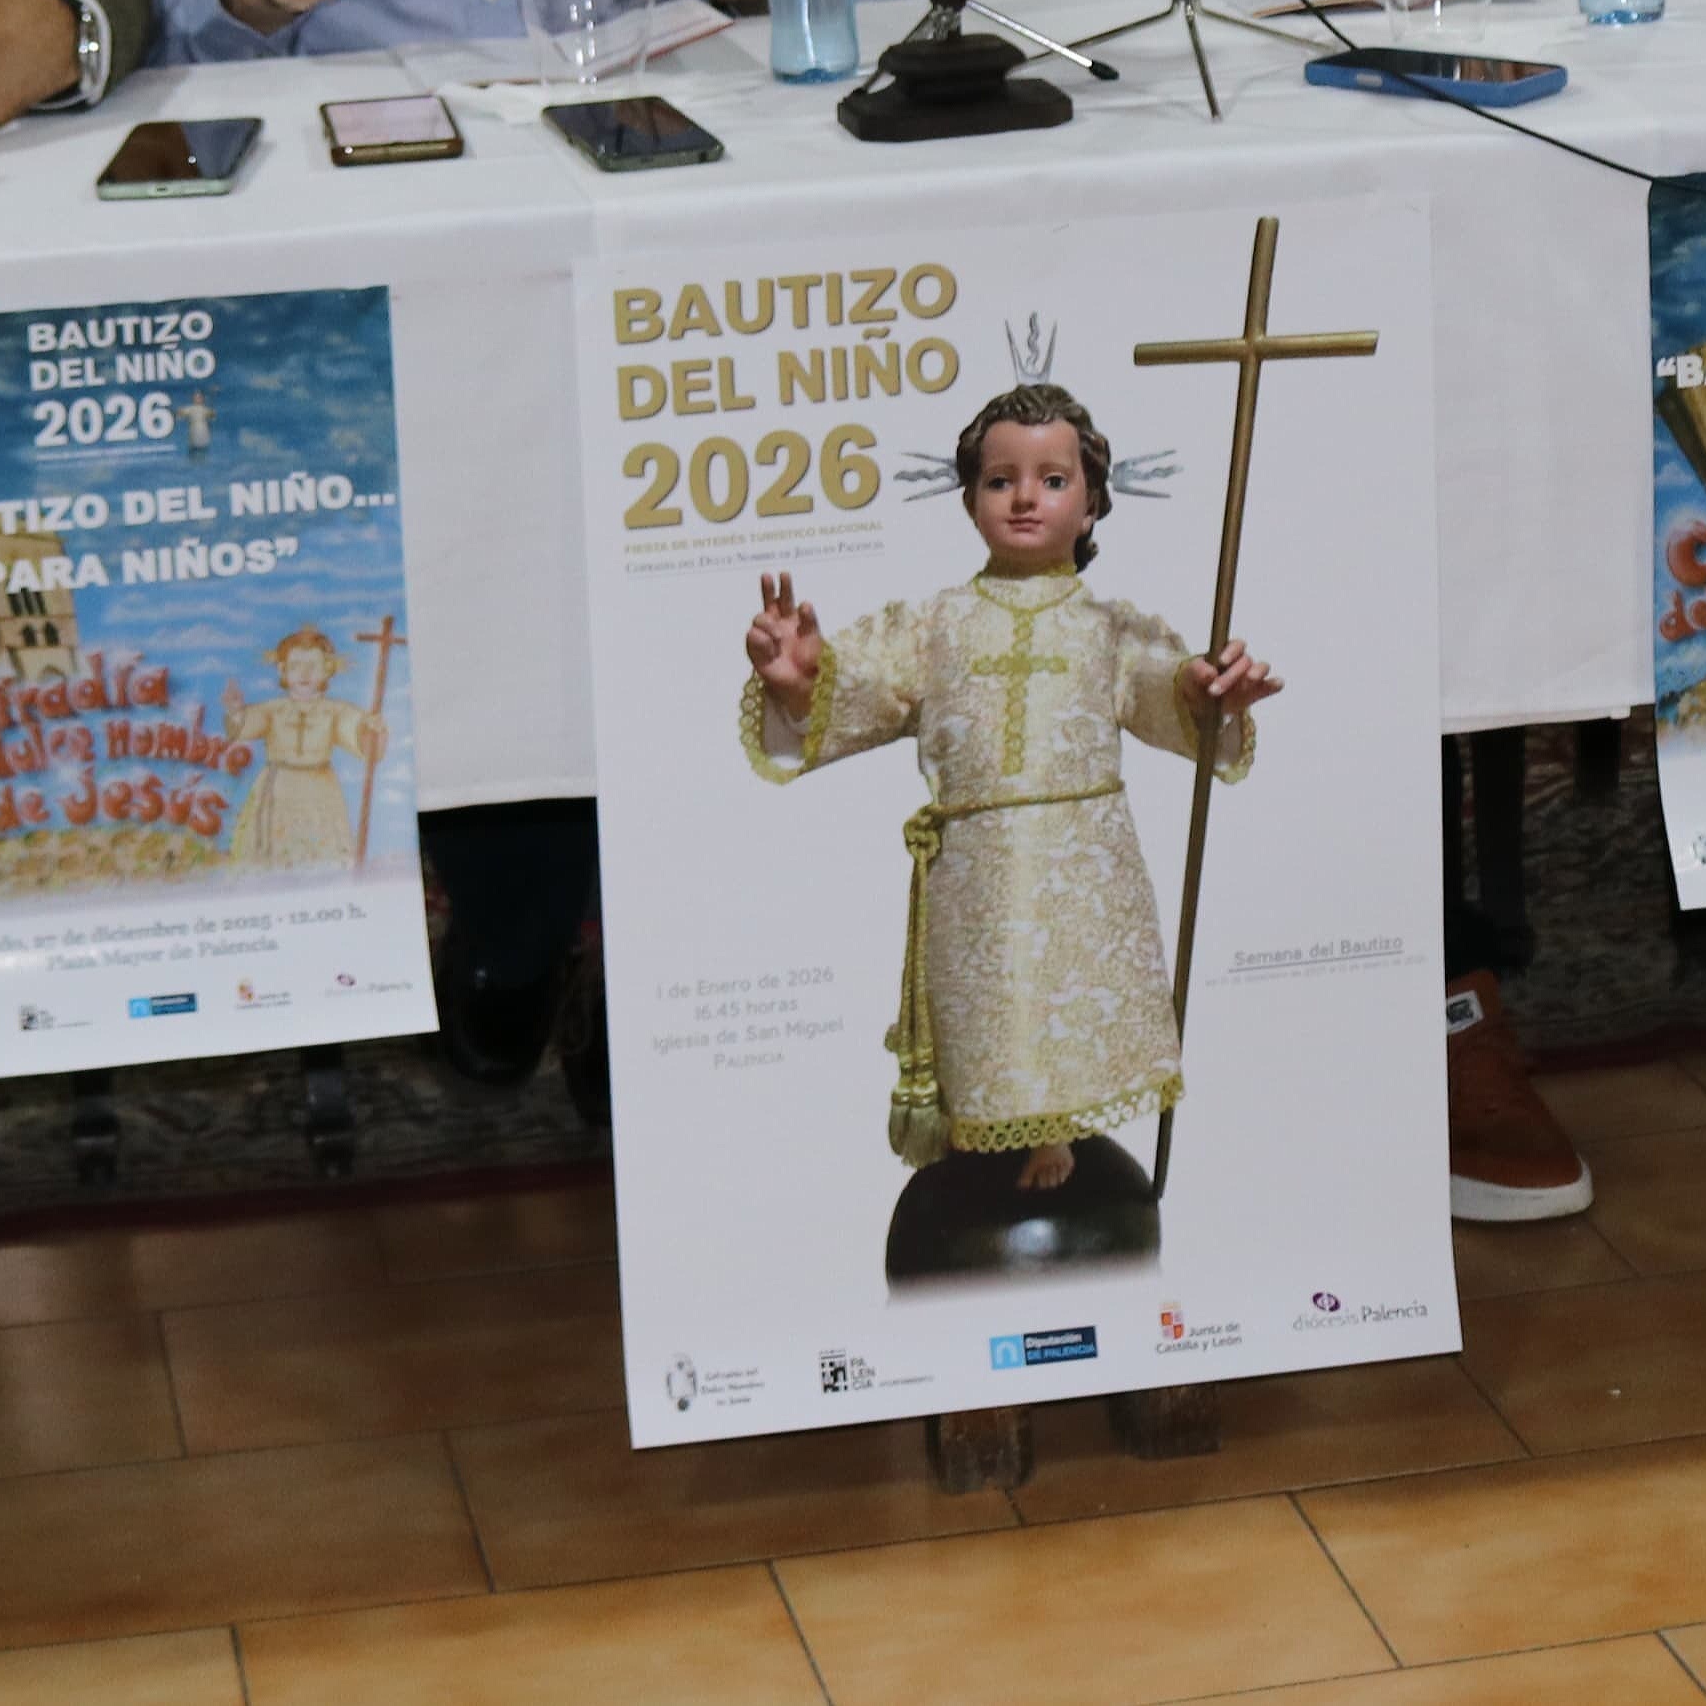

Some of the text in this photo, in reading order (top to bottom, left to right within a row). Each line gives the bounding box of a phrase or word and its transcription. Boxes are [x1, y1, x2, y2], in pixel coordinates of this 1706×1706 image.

[613, 262, 957, 345] BAUTIZO
[28, 310, 213, 353] BAUTIZO
[30, 343, 216, 391] DEL NIÑO
[617, 327, 959, 421] DEL NIÑO
[33, 391, 174, 446] 2026
[622, 424, 881, 530] 2026
[123, 488, 216, 526] DEL
[64, 928, 86, 946] de
[89, 920, 188, 943] diciembre
[195, 916, 216, 934] de
[223, 915, 271, 932] 2025
[348, 902, 366, 919] h.
[102, 947, 163, 967] Mayor
[169, 943, 191, 960] de
[198, 937, 278, 958] Palencia
[1234, 936, 1403, 966] Semana del Bautizo
[668, 981, 690, 999] de
[697, 979, 751, 996] Enero
[757, 974, 780, 989] de
[786, 966, 834, 987] 2026
[746, 998, 797, 1014] horas
[652, 1016, 844, 1056] Iglesia de San Miguel
[1361, 1303, 1429, 1322] Palencia
[1156, 1339, 1198, 1354] Castilla
[1212, 1335, 1242, 1350] León
